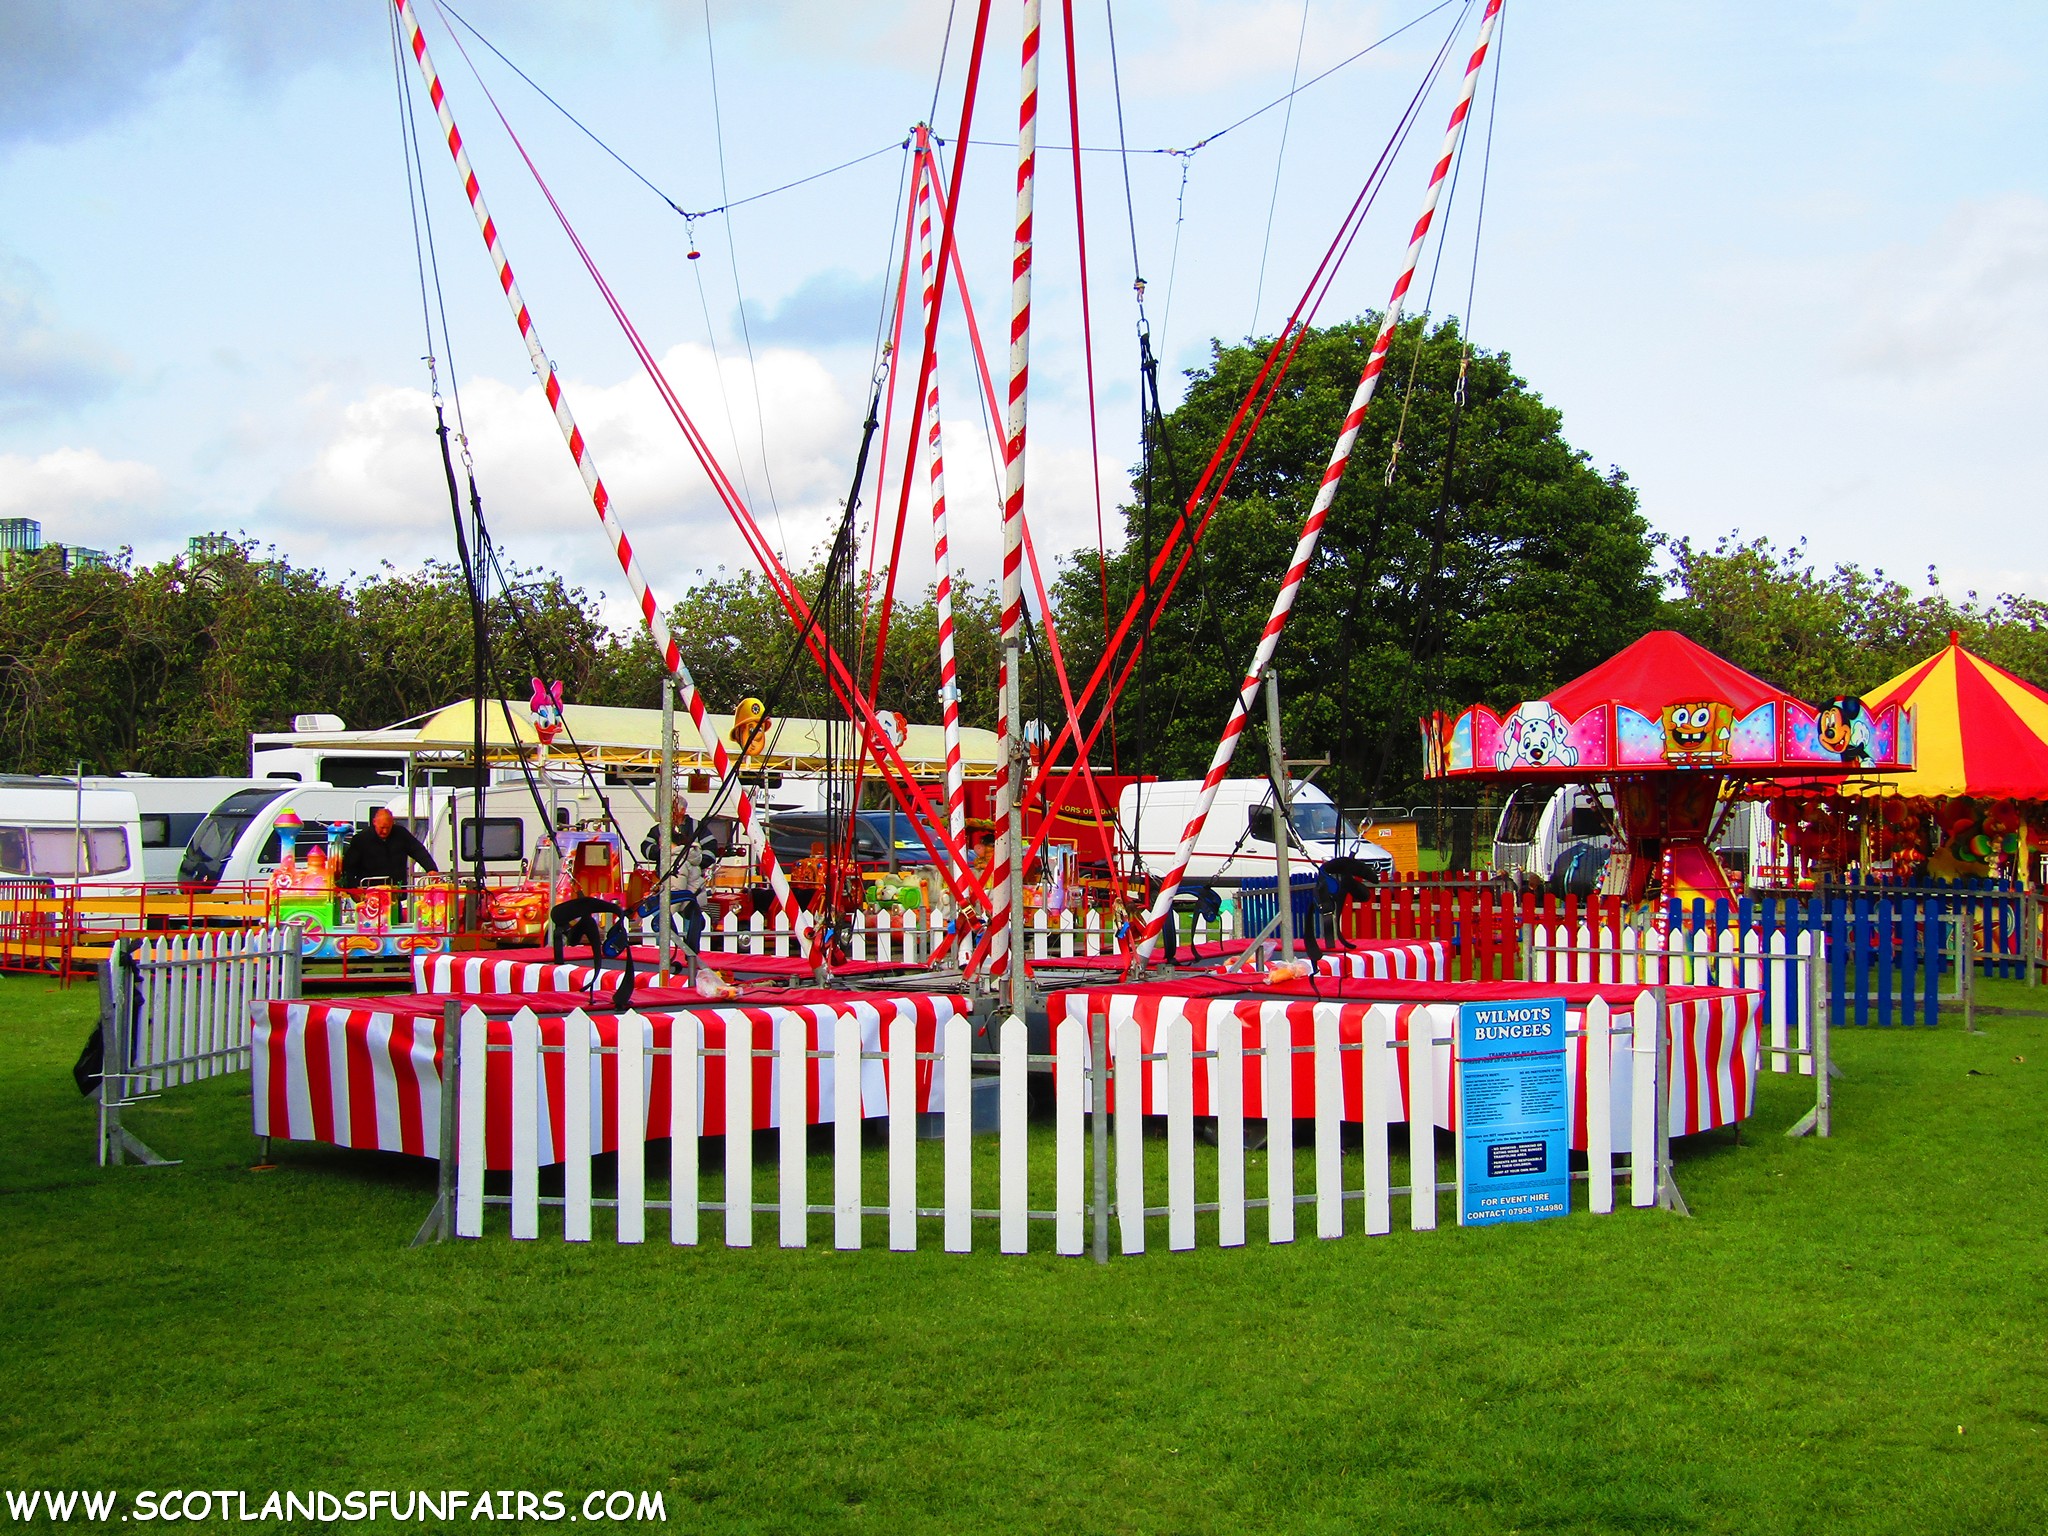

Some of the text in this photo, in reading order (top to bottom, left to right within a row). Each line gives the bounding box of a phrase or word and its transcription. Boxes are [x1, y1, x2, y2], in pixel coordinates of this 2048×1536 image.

[1475, 1008, 1551, 1024] WILMOTS
[1474, 1023, 1551, 1040] BUNGEES
[1481, 1193, 1549, 1206] FOR EVENT HIRE
[1467, 1209, 1506, 1220] CONTACT
[1508, 1206, 1533, 1215] 07958
